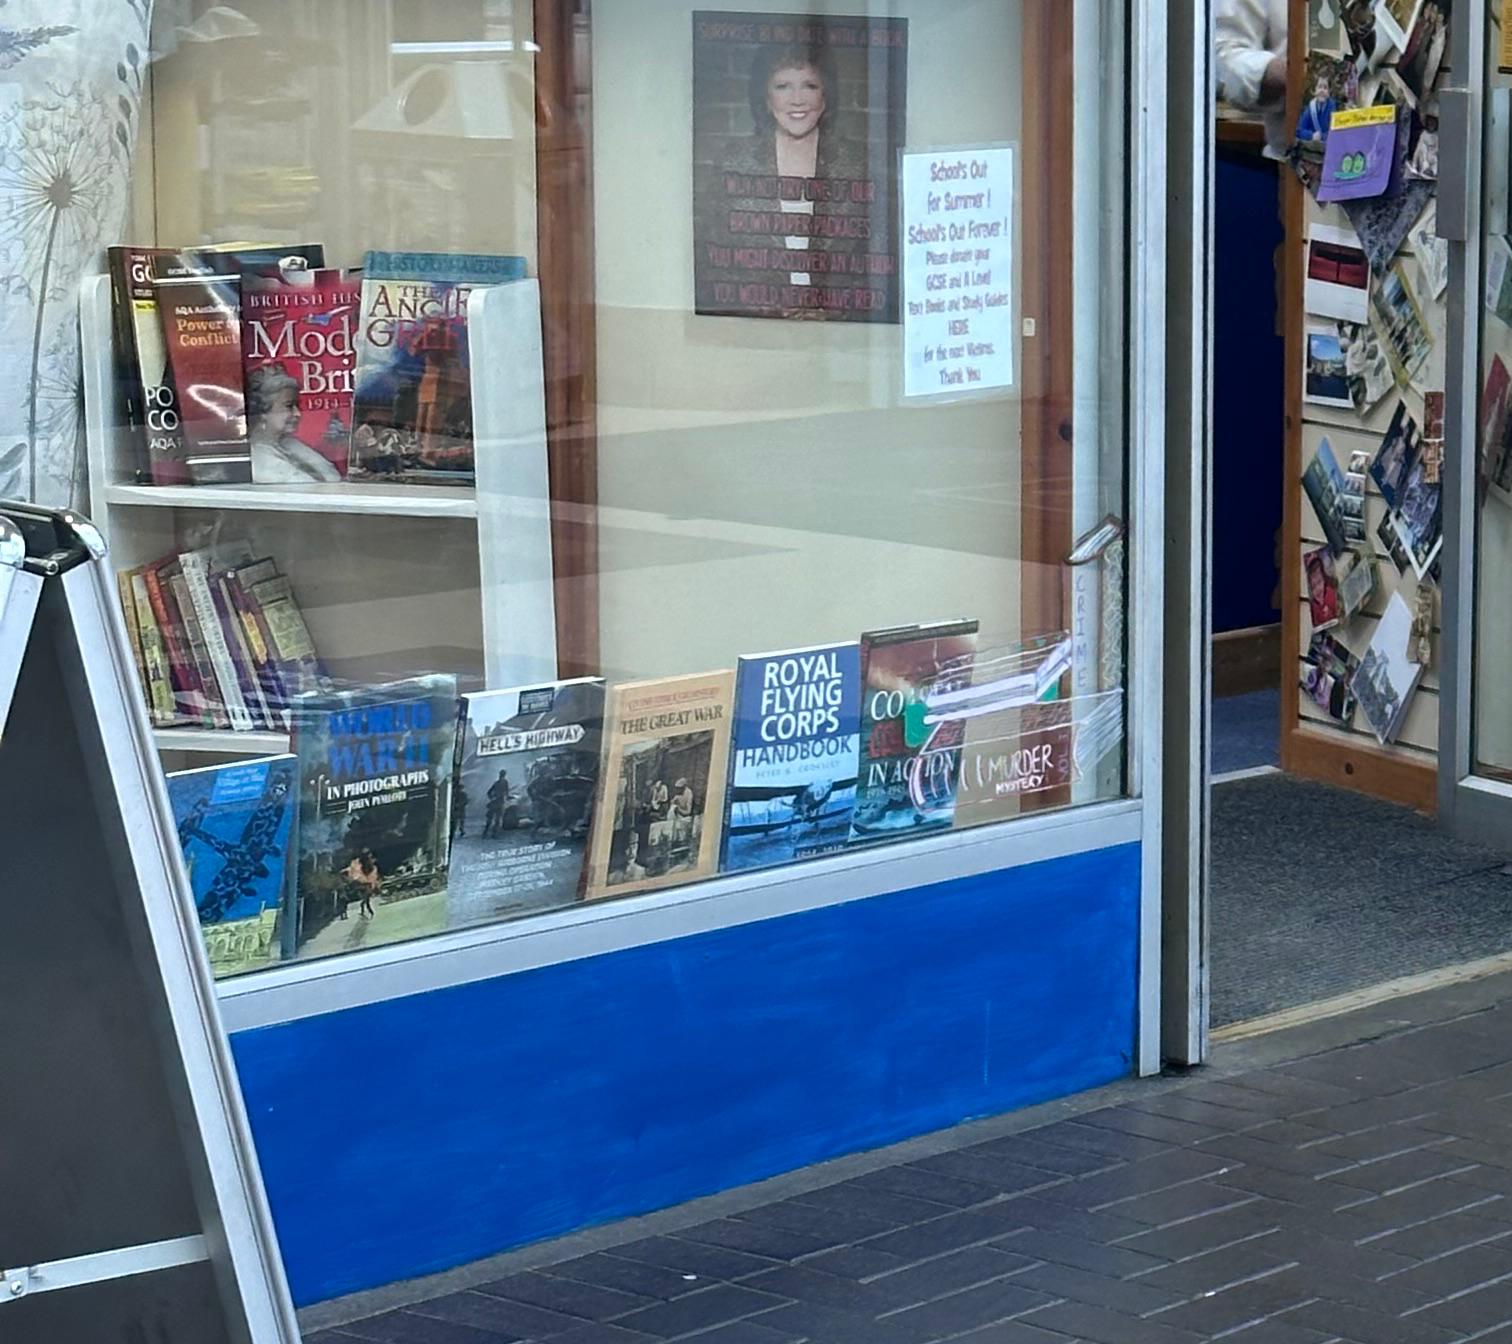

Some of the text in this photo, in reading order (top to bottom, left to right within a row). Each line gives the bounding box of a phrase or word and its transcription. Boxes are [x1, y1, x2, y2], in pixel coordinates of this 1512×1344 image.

[930, 159, 988, 183] School's Out
[851, 181, 876, 202] OUR
[944, 191, 985, 211] Summer
[730, 211, 871, 239] BROWN PAPER PACKAGES
[908, 222, 946, 245] School's
[949, 222, 966, 242] Out
[397, 285, 440, 298] THE
[926, 273, 948, 291] GCSE
[250, 293, 324, 307] BRITISH
[176, 319, 221, 332] Power
[948, 318, 969, 336] HERE
[179, 333, 239, 348] Conflict
[939, 367, 964, 385] Thank
[150, 437, 177, 455] AQA
[1075, 574, 1089, 689] CRIME
[763, 652, 843, 689] ROYAL
[760, 679, 843, 716] FLYING
[328, 698, 431, 736] WORLD
[621, 704, 724, 736] THE GREAT WAR
[760, 706, 840, 742] CORPS
[480, 726, 581, 754] HELL'S HIGHWAY
[742, 735, 852, 768] HANDBOOK
[329, 734, 430, 777] WAR II
[988, 743, 1054, 780] MURDER
[867, 752, 957, 787] IN ACTION
[326, 770, 430, 801] IN PHOTOGRAPHS
[995, 774, 1045, 795] MYSTERY
[518, 845, 544, 856] STORY
